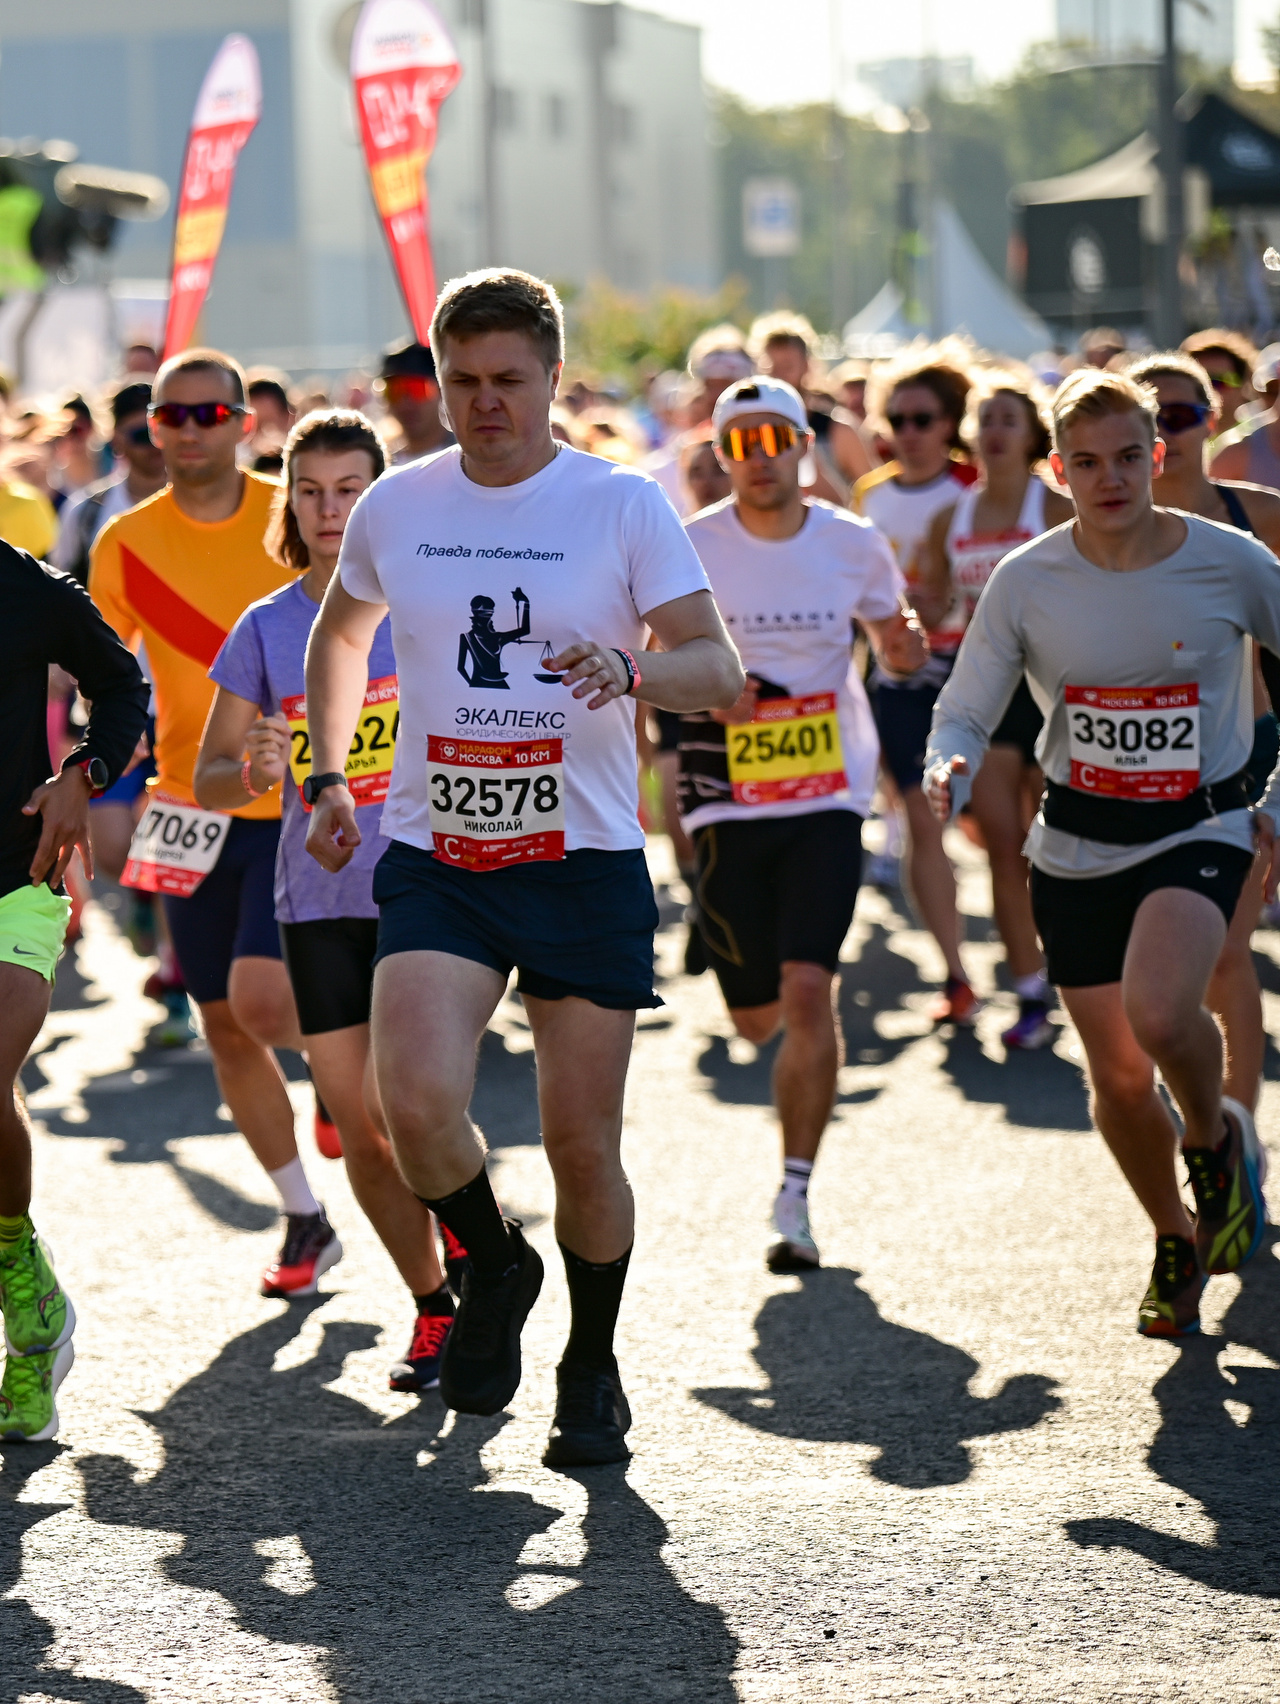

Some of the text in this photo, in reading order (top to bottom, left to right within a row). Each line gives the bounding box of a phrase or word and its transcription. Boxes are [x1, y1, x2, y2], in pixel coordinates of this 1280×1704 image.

[416, 544, 564, 562] Правда побеждает
[1155, 695, 1167, 707] 10
[455, 707, 566, 729] ЭКАЛЕКС
[456, 728, 536, 740] ЮРИДИЧЕСКИЙ
[1073, 712, 1194, 752] 33082
[734, 719, 833, 764] 25401
[459, 744, 512, 756] МАРАФОН
[344, 756, 377, 772] АРЬЯ
[459, 753, 503, 765] МОСКВА
[515, 753, 528, 764] 10
[1114, 754, 1148, 765] ИЛЬЯ
[431, 773, 559, 817] 32578
[464, 818, 523, 833] НИКОЛАЙ
